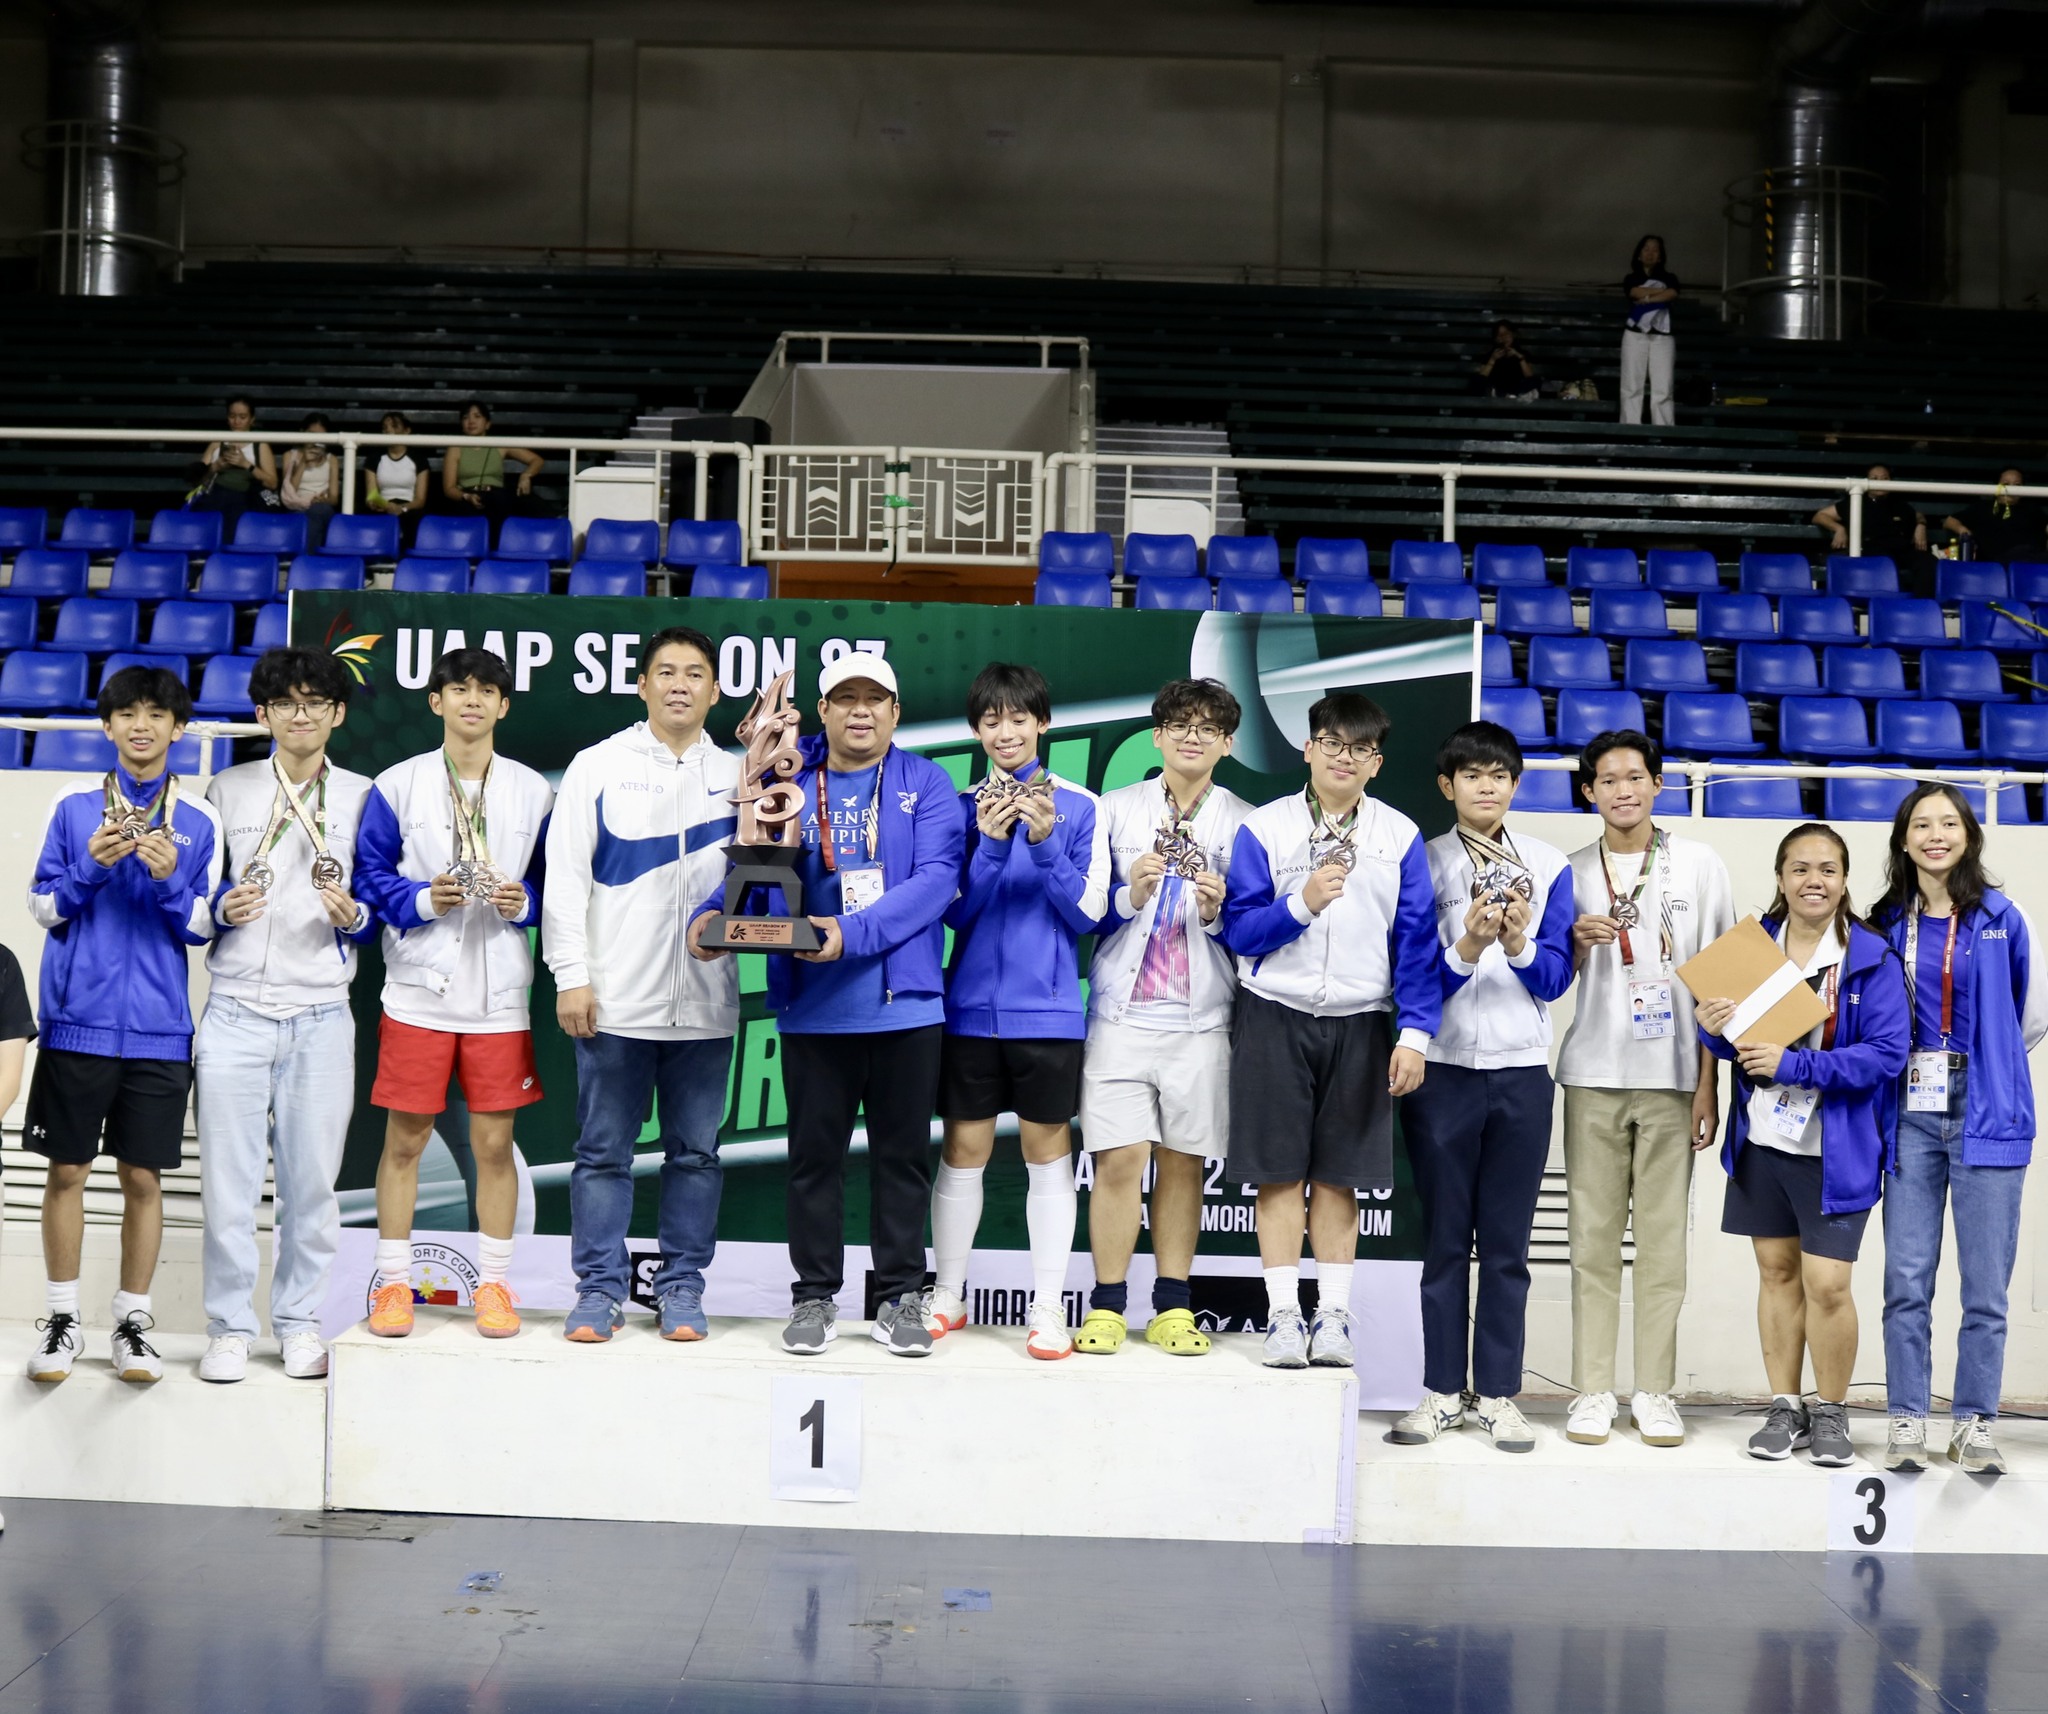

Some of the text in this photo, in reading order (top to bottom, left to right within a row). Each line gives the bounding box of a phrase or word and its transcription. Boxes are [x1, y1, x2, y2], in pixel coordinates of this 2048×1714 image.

[572, 632, 797, 698] SEON
[806, 809, 869, 825] AENE
[1660, 991, 1667, 999] C
[1636, 1012, 1669, 1020] ATENEO
[1805, 1096, 1812, 1105] C
[414, 1248, 446, 1260] ORTS
[800, 1400, 824, 1468] 1
[1853, 1477, 1886, 1545] 3
